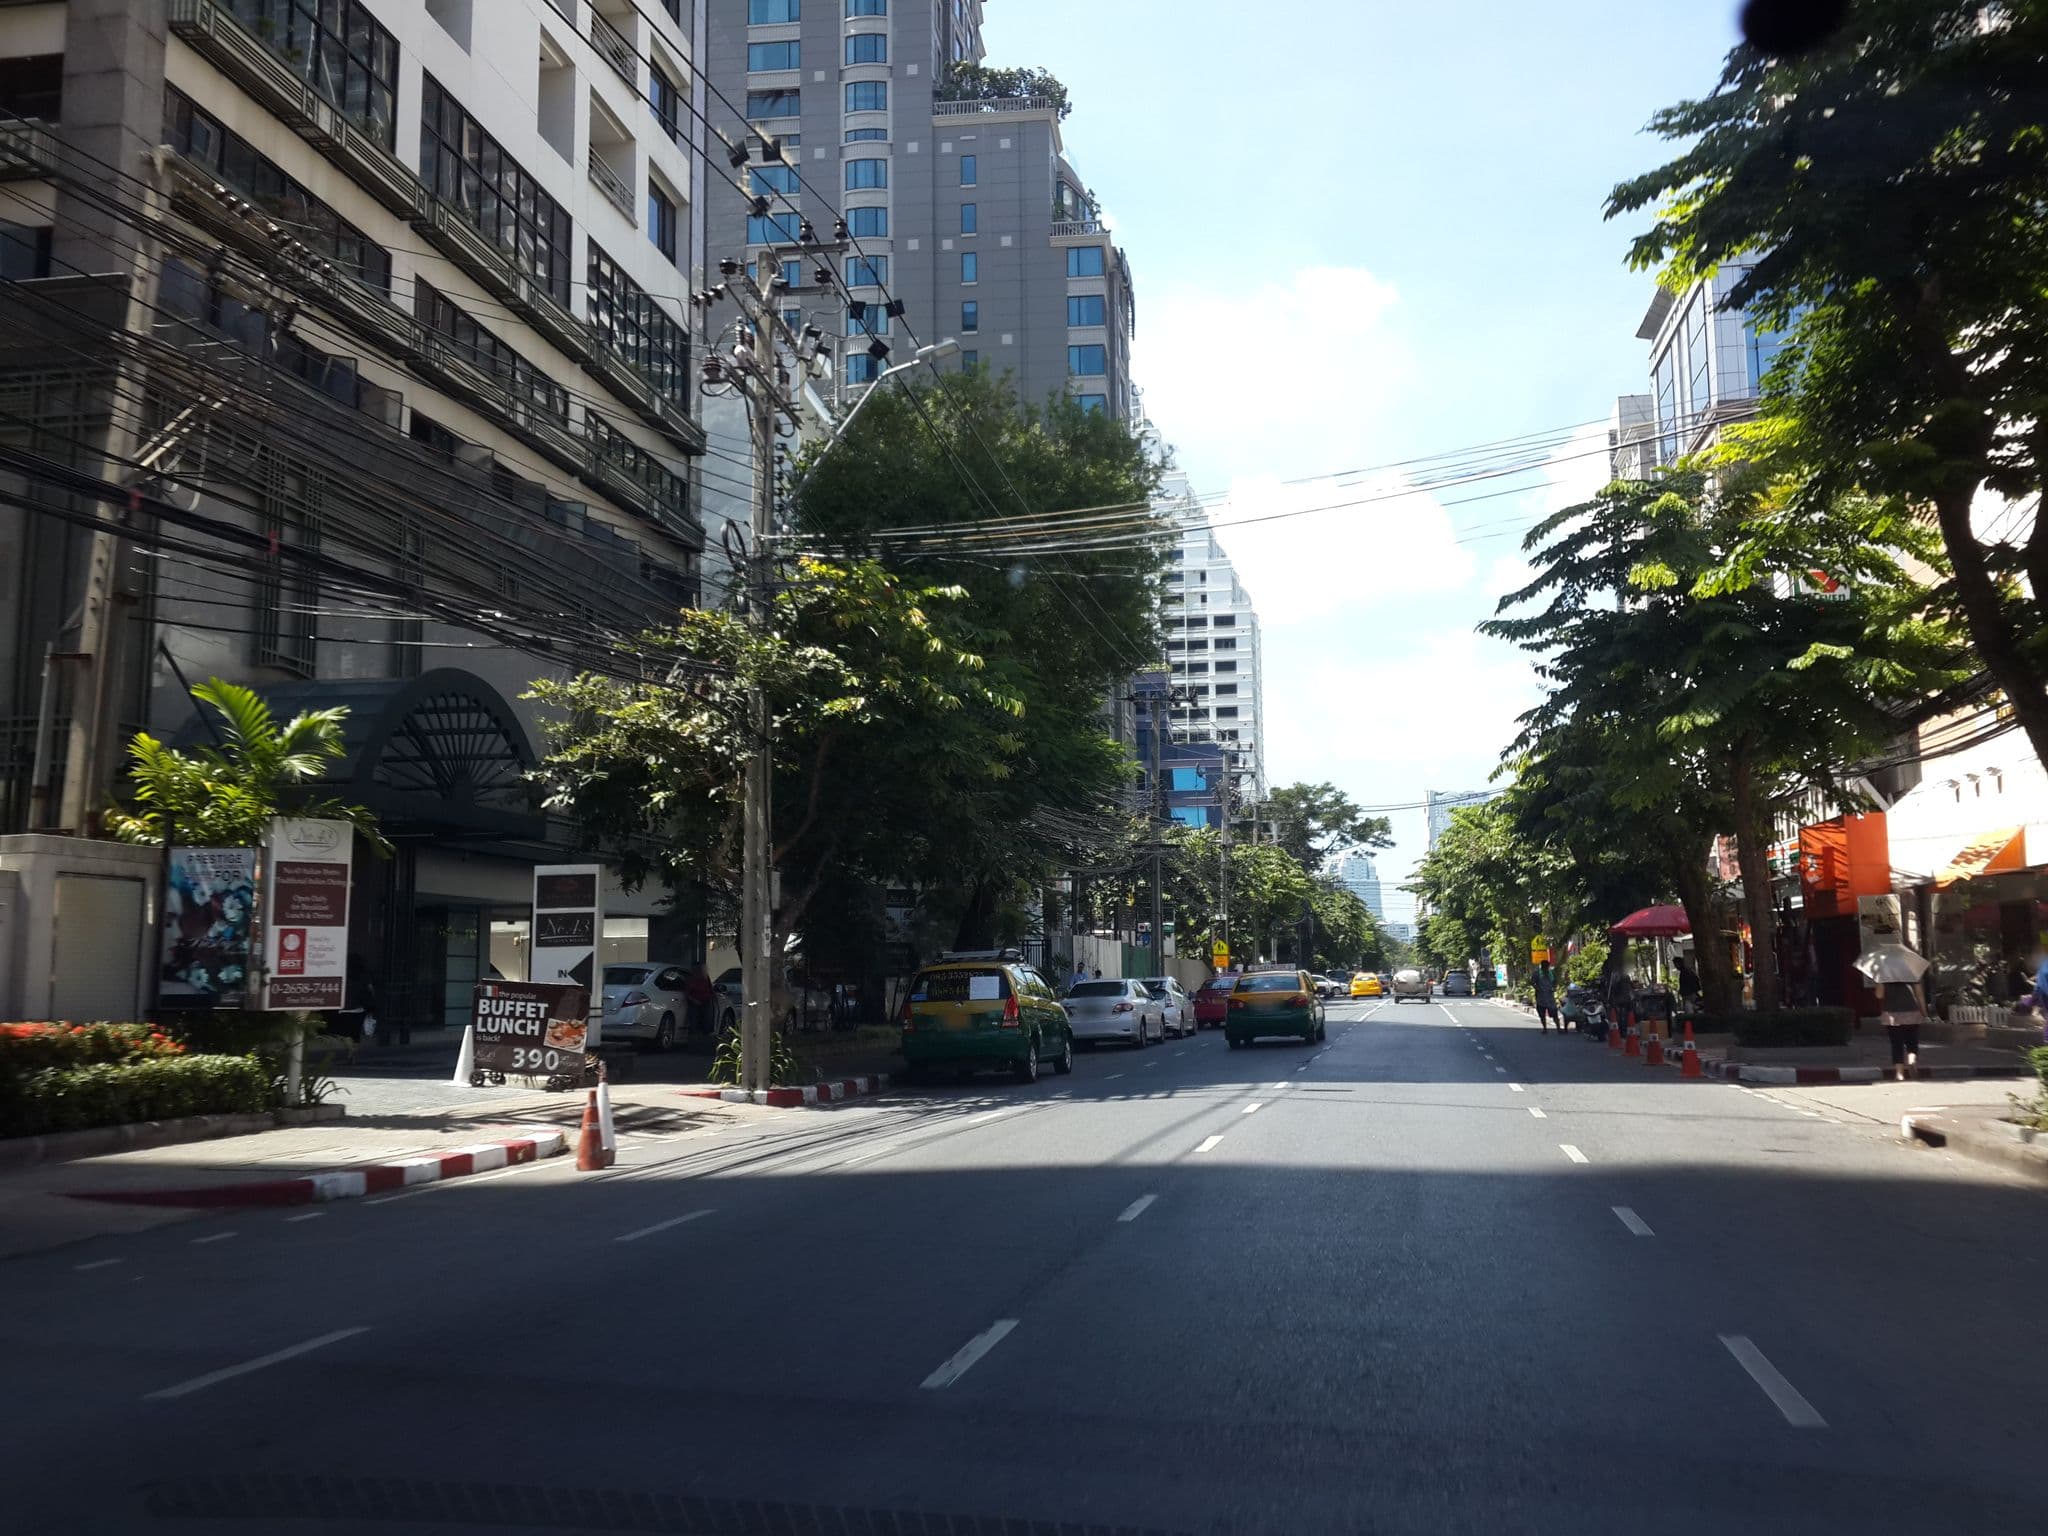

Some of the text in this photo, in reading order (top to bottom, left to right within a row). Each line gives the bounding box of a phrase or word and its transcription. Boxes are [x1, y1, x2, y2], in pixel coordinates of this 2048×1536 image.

[187, 854, 243, 864] PRESTIGE
[215, 870, 242, 882] FOR
[280, 960, 302, 968] BEST
[557, 969, 568, 978] IN
[511, 991, 537, 1000] popular
[478, 998, 549, 1019] BUFFET
[476, 1016, 540, 1036] LUNCH
[511, 1047, 560, 1071] 390
